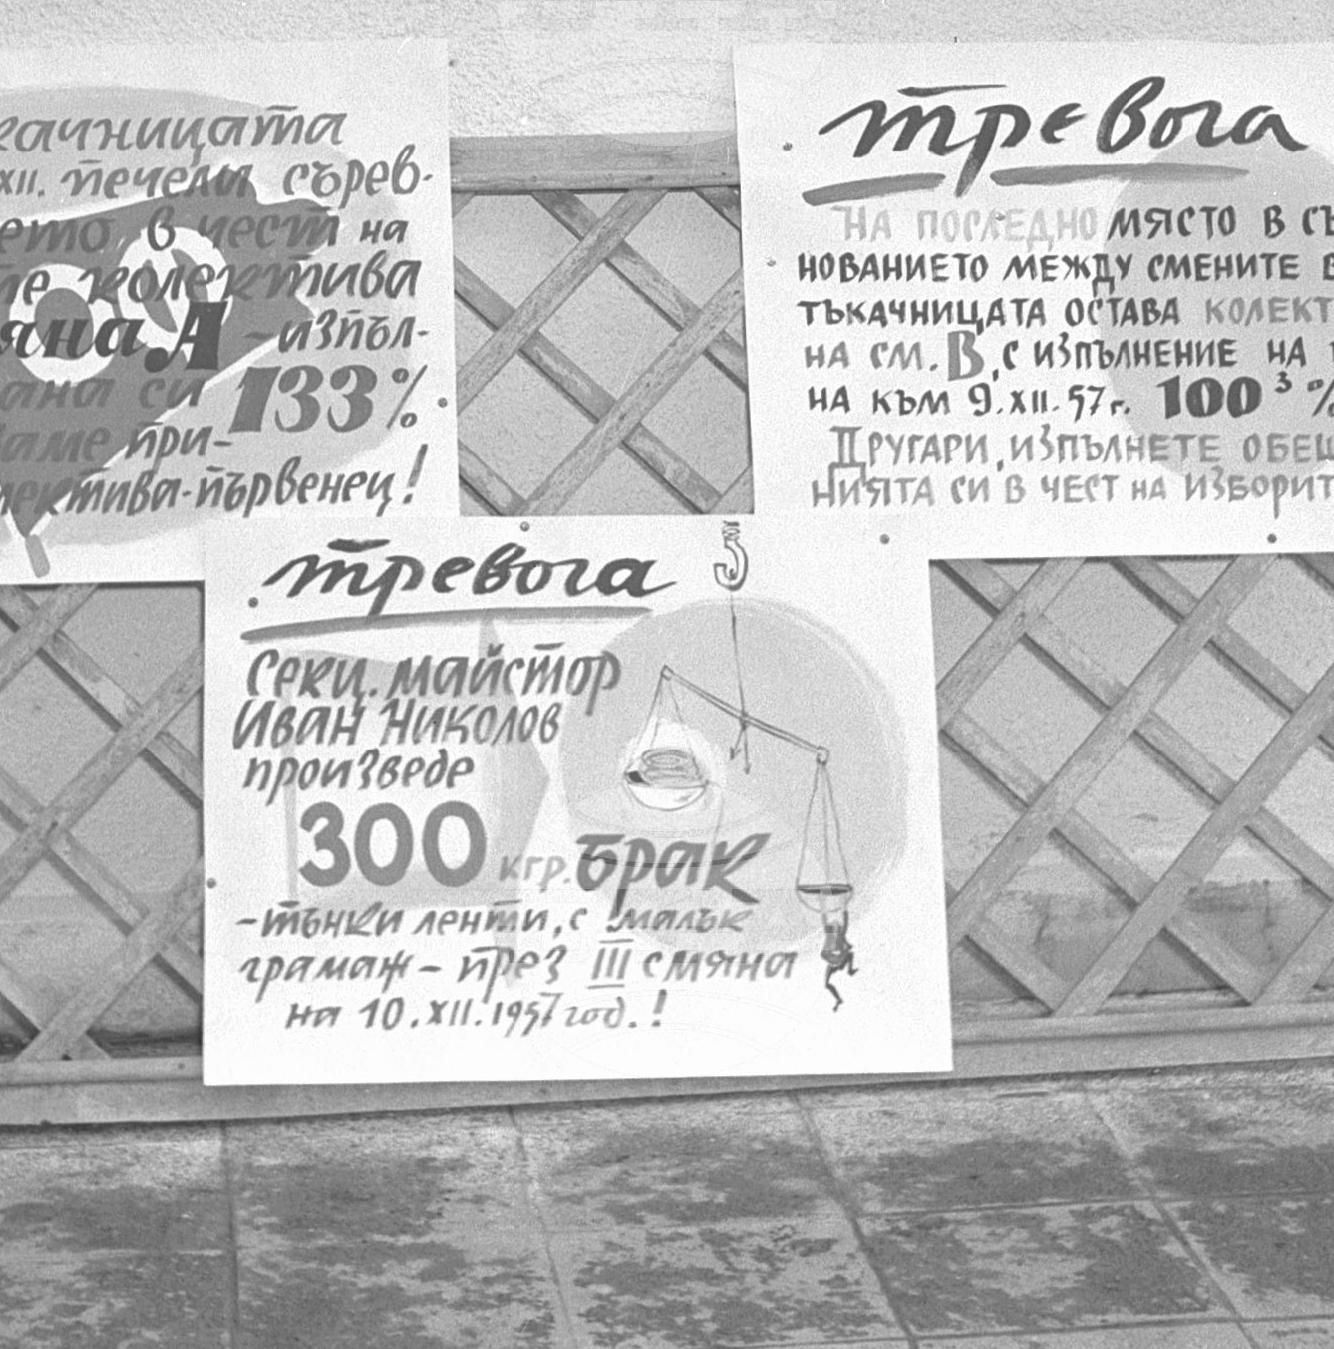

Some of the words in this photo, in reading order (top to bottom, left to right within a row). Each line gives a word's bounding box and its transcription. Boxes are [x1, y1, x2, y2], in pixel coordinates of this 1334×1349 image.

[60, 159, 253, 199] печели
[283, 144, 433, 209] сърев-
[148, 205, 176, 252] в
[198, 206, 340, 250] чест
[359, 218, 410, 244] на
[830, 205, 893, 242] НА
[916, 207, 1098, 252] ПОСЛЕДНО
[1108, 204, 1236, 240] МЯСТО
[1263, 204, 1286, 239] В
[78, 250, 422, 305] колектива
[797, 252, 989, 283] НОВАНИЕТО
[1003, 252, 1133, 298] МЕЖДУ
[1147, 252, 1301, 282] СМЕНИТЕ
[797, 297, 1047, 336] ТЪКАЧНИЦАТА
[1065, 297, 1180, 327] ОСТАВА
[805, 340, 850, 369] НА
[870, 341, 939, 372] СМ.
[1003, 339, 1019, 371] С
[1033, 331, 1238, 371] ИЗПЪЛНЕНИЕ
[1267, 336, 1307, 367] НА
[808, 385, 850, 414] НА
[872, 388, 950, 416] КЪМ
[1010, 423, 1221, 464] ИЗПЪЛНЕТЕ
[812, 475, 935, 508] НИЯТА
[951, 475, 990, 504] СИ
[1005, 474, 1027, 504] В
[1041, 474, 1121, 504] ЧЕСТ
[1132, 476, 1167, 502] НА
[261, 538, 677, 615] тревога
[389, 642, 621, 716] майстор
[232, 698, 366, 750] Иван
[380, 698, 563, 748] Николов
[242, 748, 475, 806] произведе
[299, 800, 488, 888] 300
[570, 907, 589, 932] с
[605, 907, 754, 933] малък
[238, 949, 415, 1003] грамаж
[456, 945, 568, 1004] през
[642, 949, 799, 983] смяна
[284, 1002, 342, 1029] на
